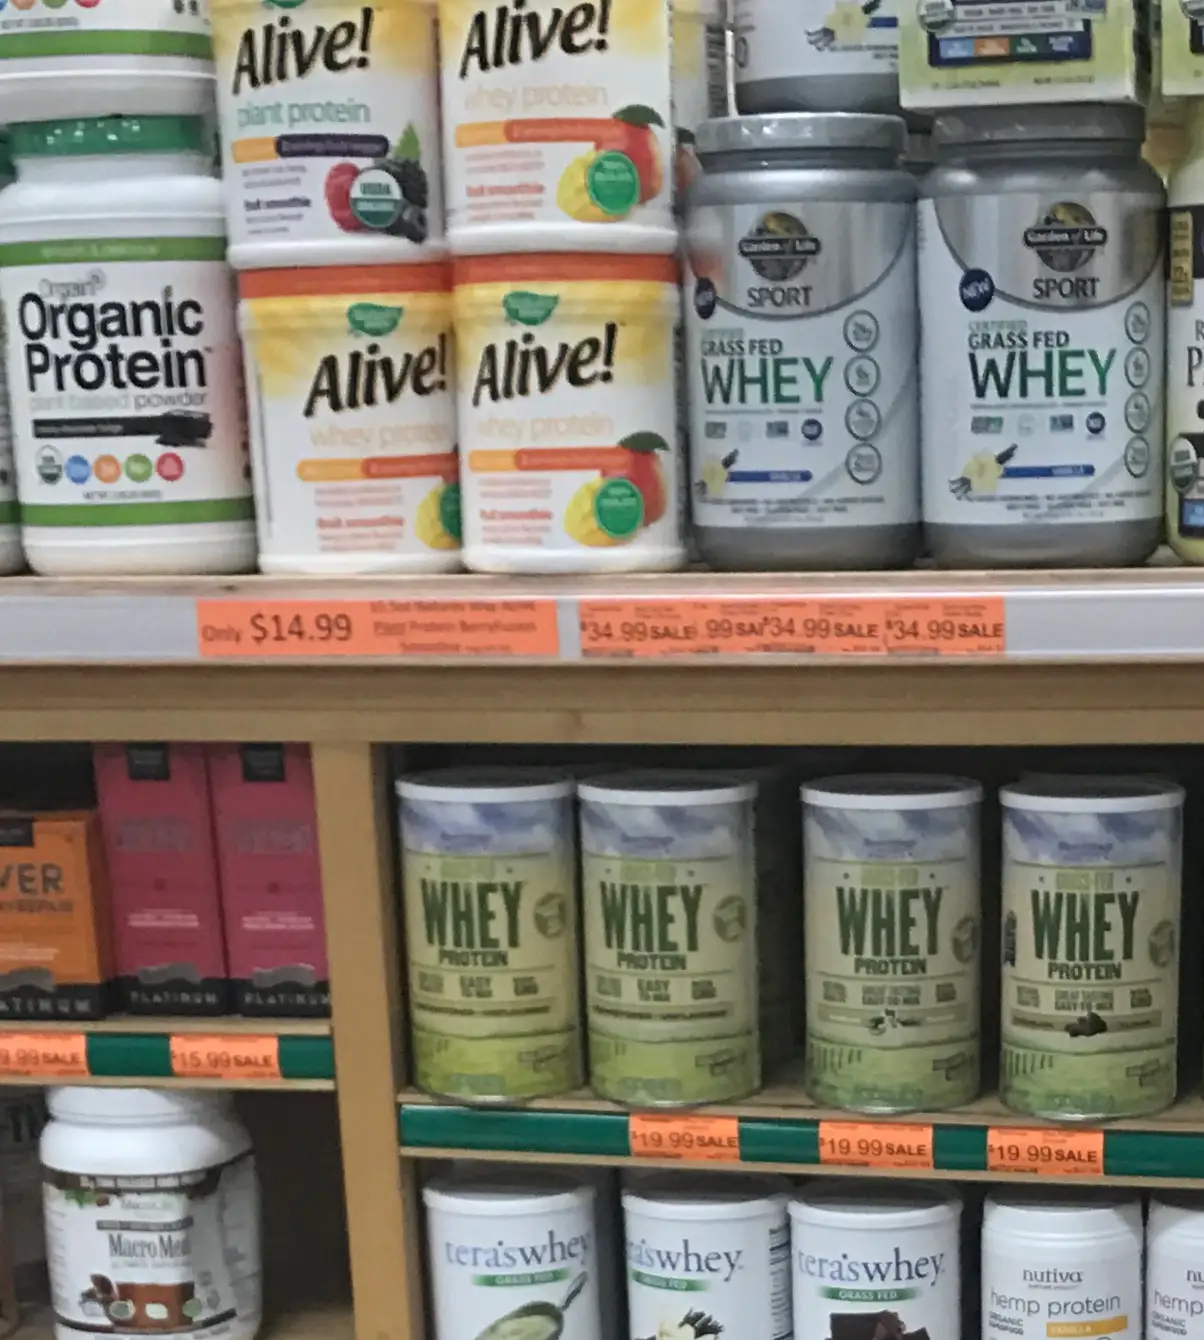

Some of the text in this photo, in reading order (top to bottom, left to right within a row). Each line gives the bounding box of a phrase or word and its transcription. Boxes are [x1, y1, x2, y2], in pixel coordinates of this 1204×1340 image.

[232, 7, 373, 95] Alive!
[459, 0, 611, 79] Alive!
[287, 99, 371, 126] protein
[748, 286, 812, 307] SPORT
[1033, 277, 1100, 299] SPORT
[19, 285, 204, 350] Organic
[748, 338, 783, 354] FED
[968, 330, 1069, 349] GRASS FED
[25, 338, 208, 393] Protein
[304, 333, 448, 418] Alive!
[473, 322, 619, 407] Alive!
[969, 349, 1117, 398] WHEY
[701, 356, 833, 404] WHEY
[250, 611, 354, 645] $14.99
[834, 622, 878, 638] SALE
[958, 623, 1002, 639] SALE
[420, 878, 525, 949] WHEY
[600, 881, 705, 951] WHEY
[836, 885, 944, 956] WHEY
[1030, 888, 1140, 961] WHEY
[854, 957, 928, 975] PROTEIN
[1048, 962, 1122, 980] PROTEIN
[233, 1054, 272, 1067] SALE
[696, 1135, 738, 1149] SALE
[885, 1142, 928, 1158] SALE
[1054, 1147, 1098, 1164] SALE
[108, 1233, 157, 1258] Macro
[1023, 1267, 1083, 1284] nutiva
[879, 1291, 899, 1300] FED
[988, 1290, 1121, 1319] hemp protein
[1154, 1289, 1204, 1317] hemp
